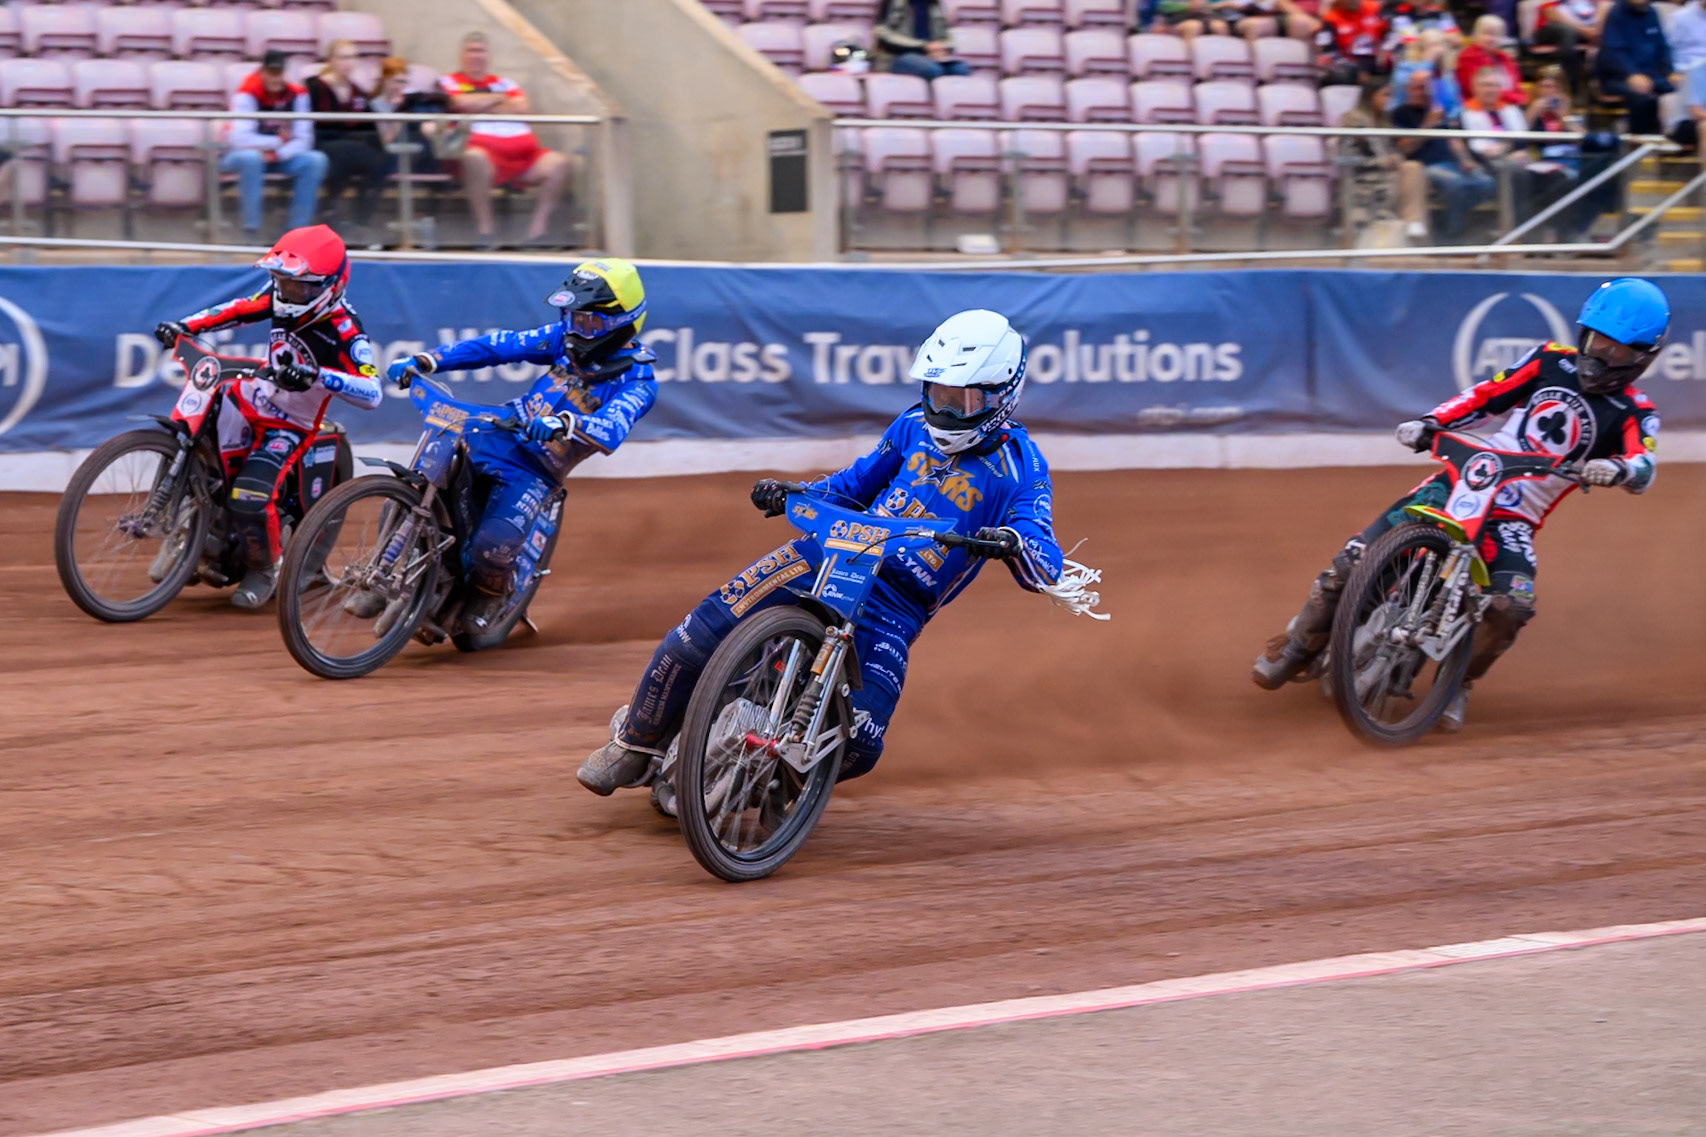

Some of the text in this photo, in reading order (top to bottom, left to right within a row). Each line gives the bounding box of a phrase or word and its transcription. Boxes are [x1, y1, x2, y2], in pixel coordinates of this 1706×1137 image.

[637, 327, 792, 383] Class
[803, 331, 926, 385] Trav
[1020, 329, 1244, 384] olutions
[1566, 396, 1584, 415] VUE
[845, 521, 891, 545] PSH
[738, 544, 804, 588] PSH
[896, 553, 938, 587] LYNN
[736, 573, 789, 614] ENVIRONMENTAL
